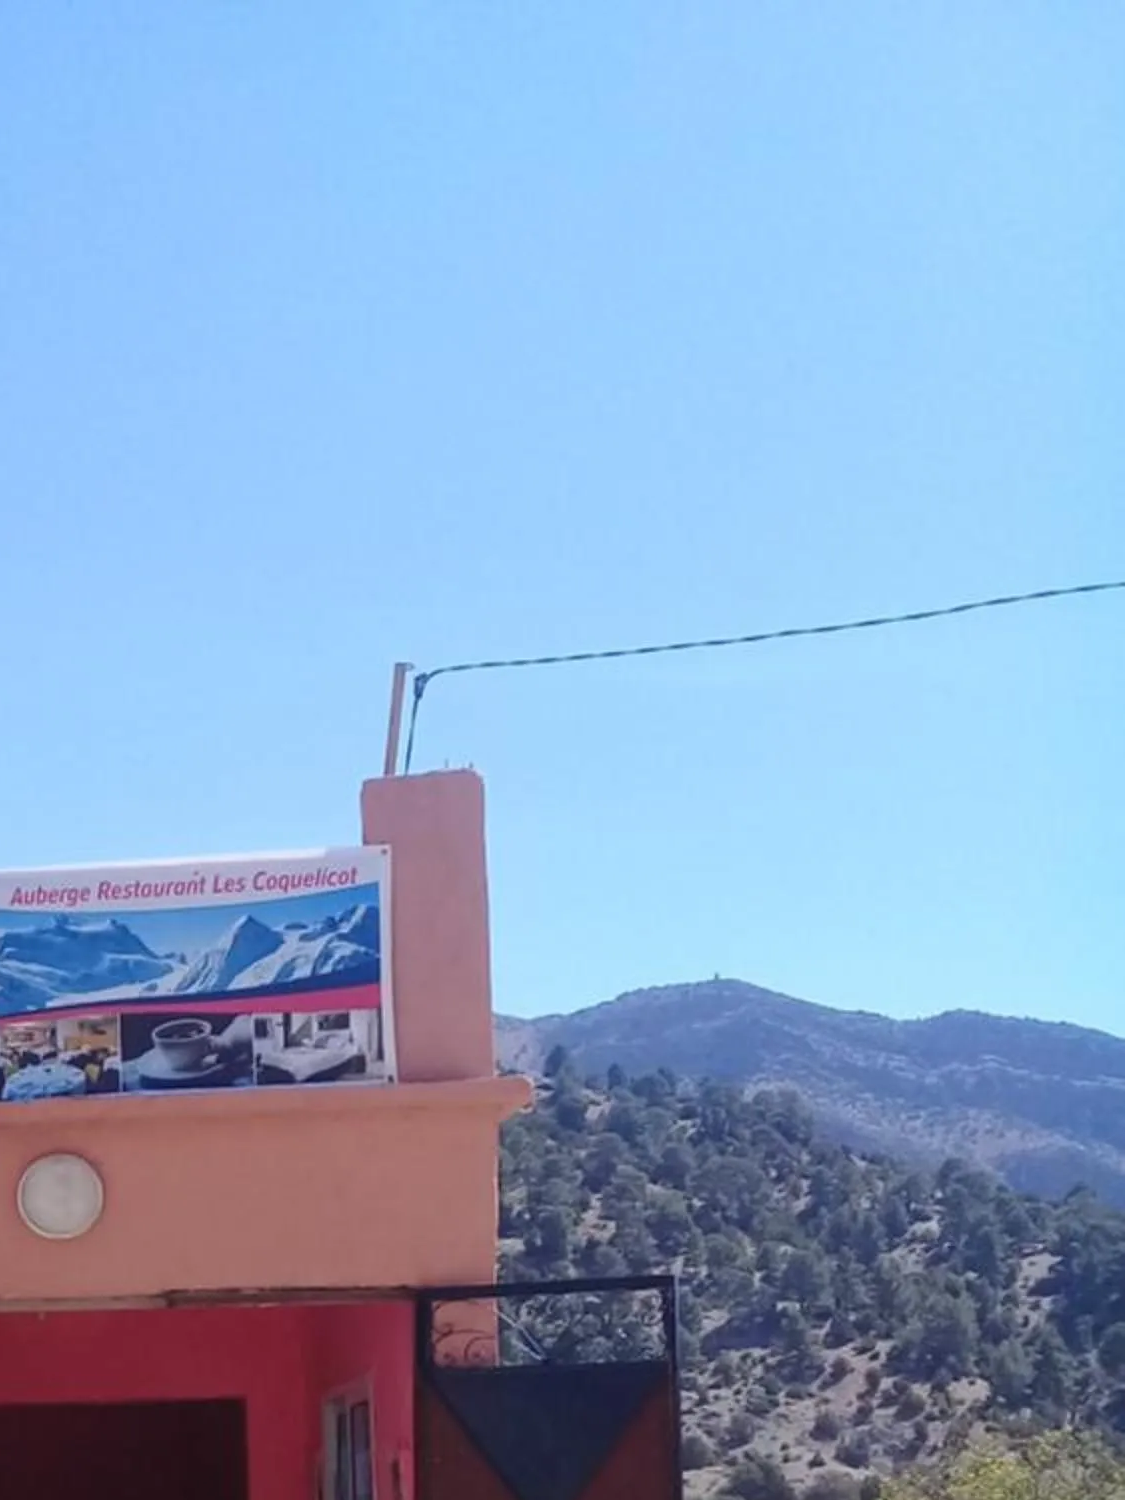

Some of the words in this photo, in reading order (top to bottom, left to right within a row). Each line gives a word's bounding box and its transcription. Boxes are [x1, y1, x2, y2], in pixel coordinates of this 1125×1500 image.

[10, 885, 90, 907] Auberge
[96, 876, 206, 901] Restaurant
[212, 873, 246, 894] Les
[252, 867, 358, 893] Coquelicot
